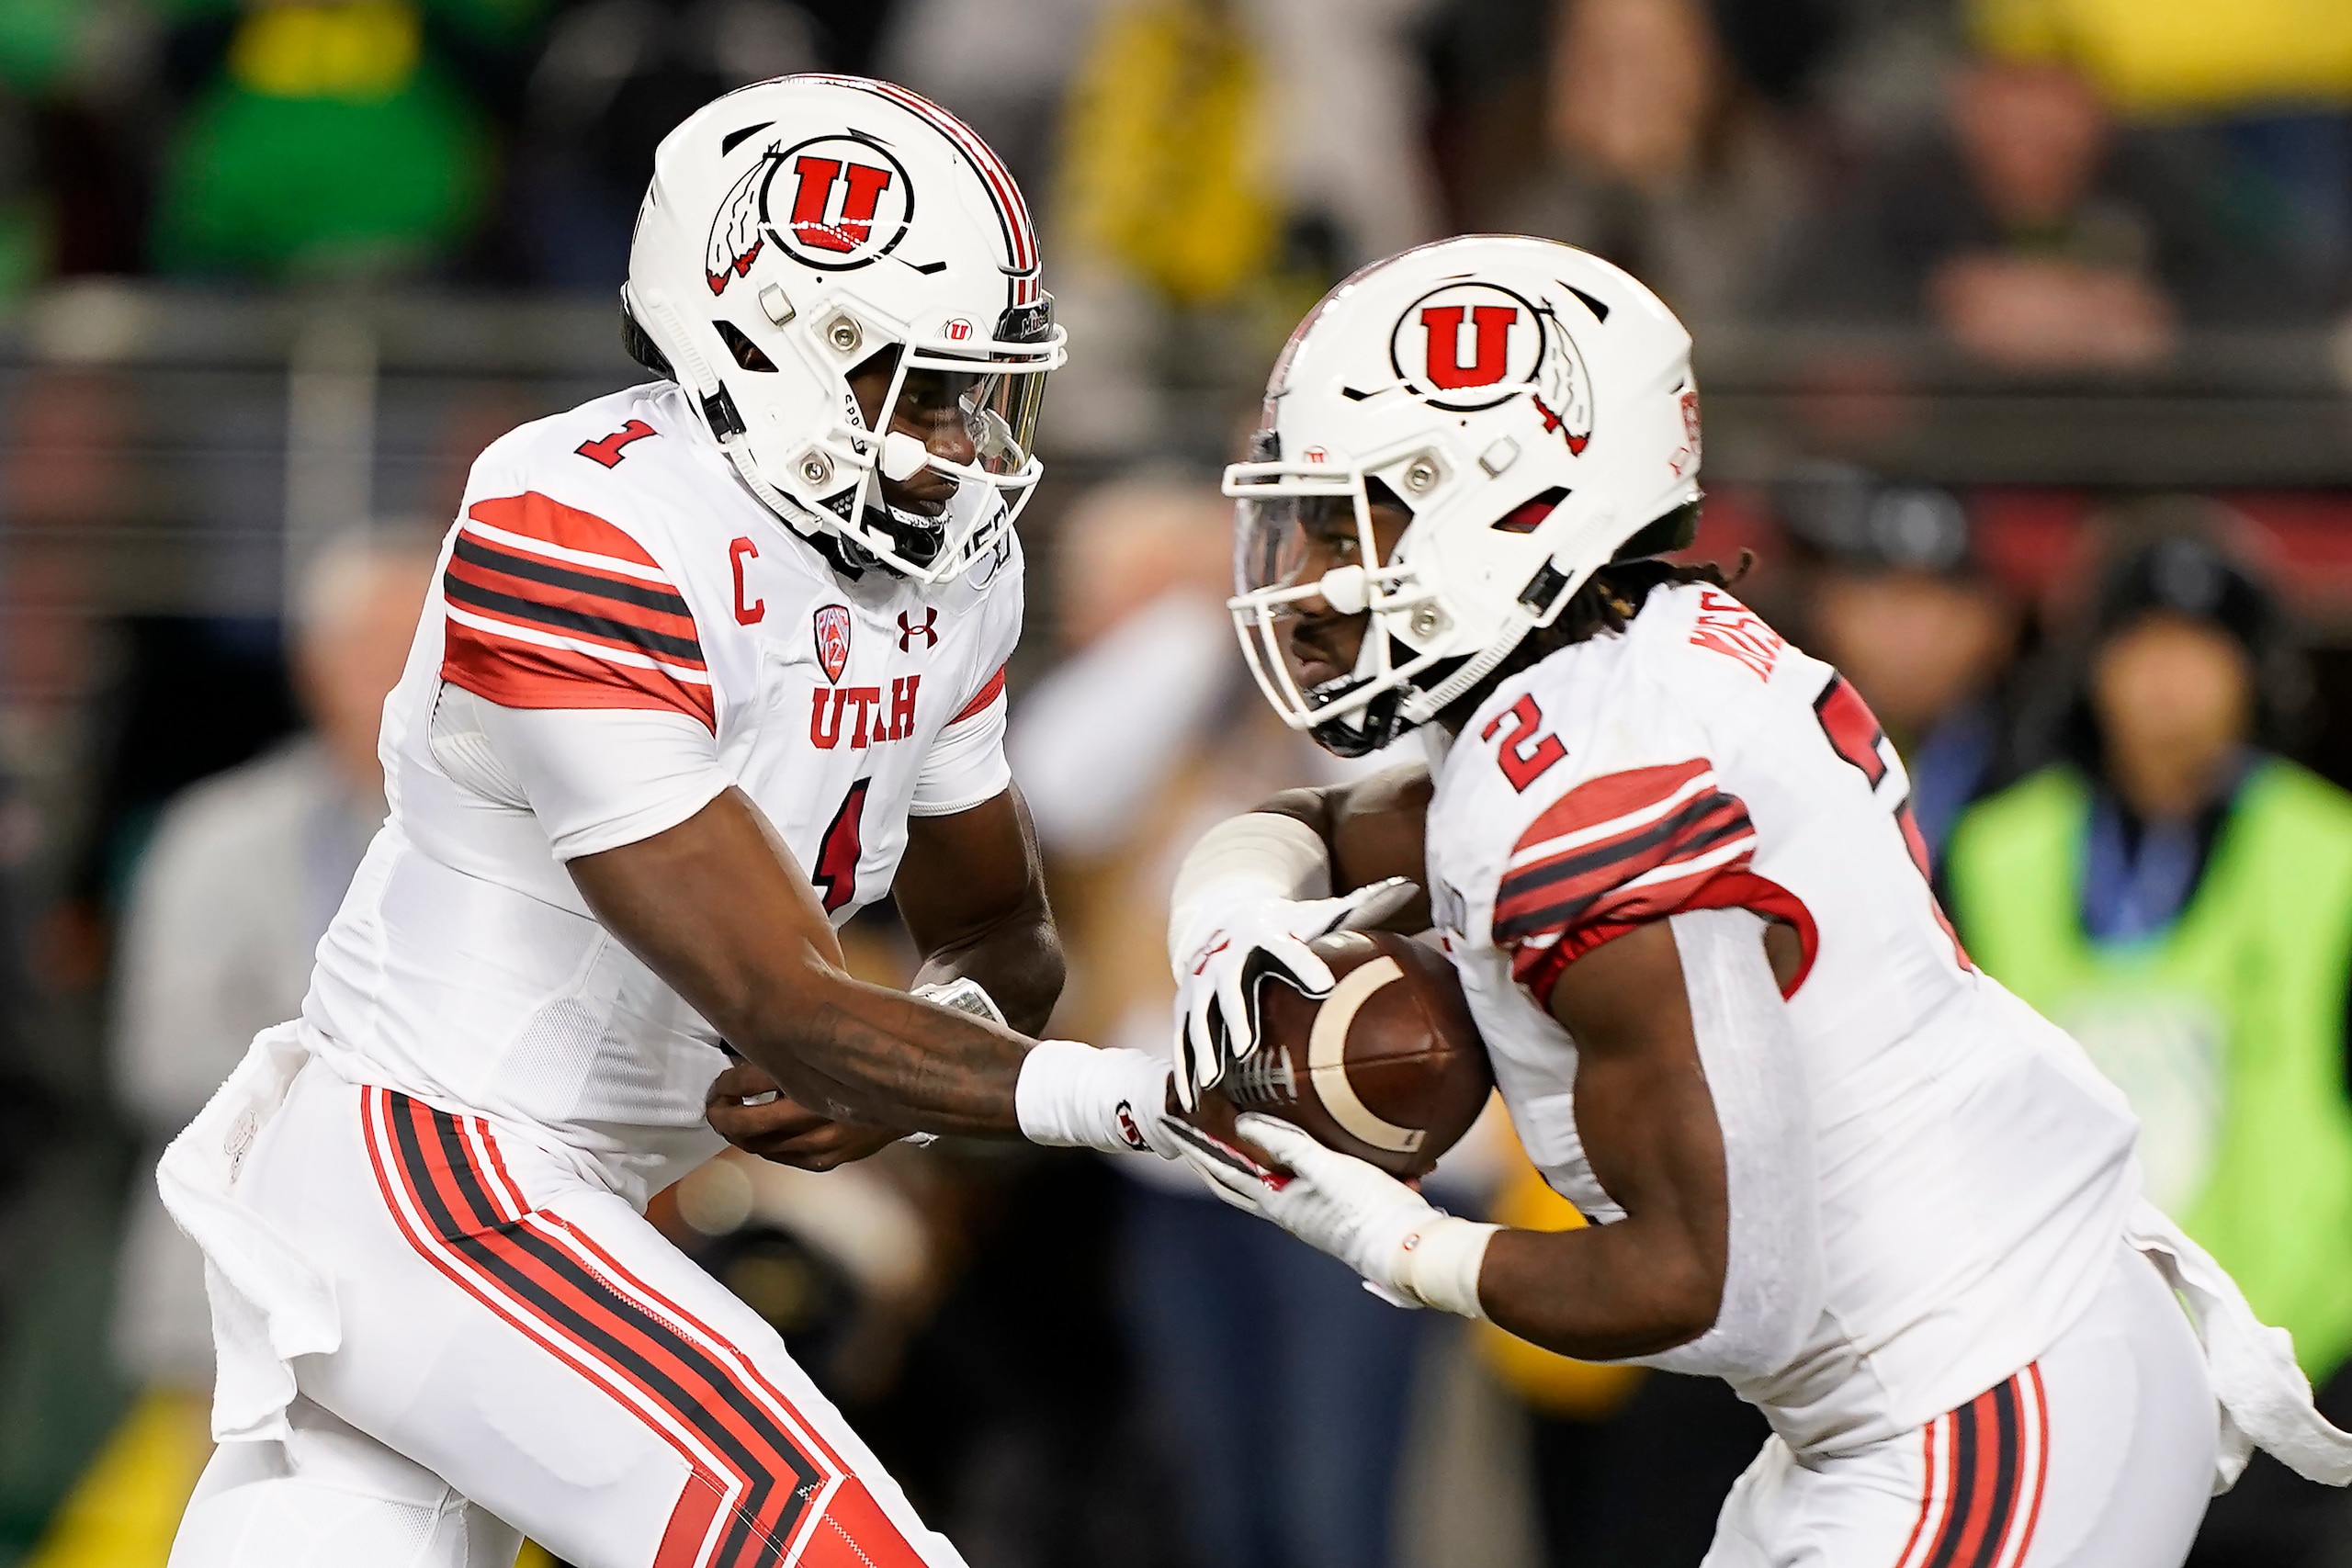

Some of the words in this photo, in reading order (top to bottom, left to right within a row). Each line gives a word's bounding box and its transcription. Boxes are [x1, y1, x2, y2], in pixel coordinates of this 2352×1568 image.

[791, 155, 892, 254] U
[951, 323, 968, 341] U
[1421, 304, 1519, 390] U
[573, 419, 658, 470] 1
[729, 536, 765, 626] C
[810, 674, 922, 750] UTAH
[1481, 694, 1568, 794] 2
